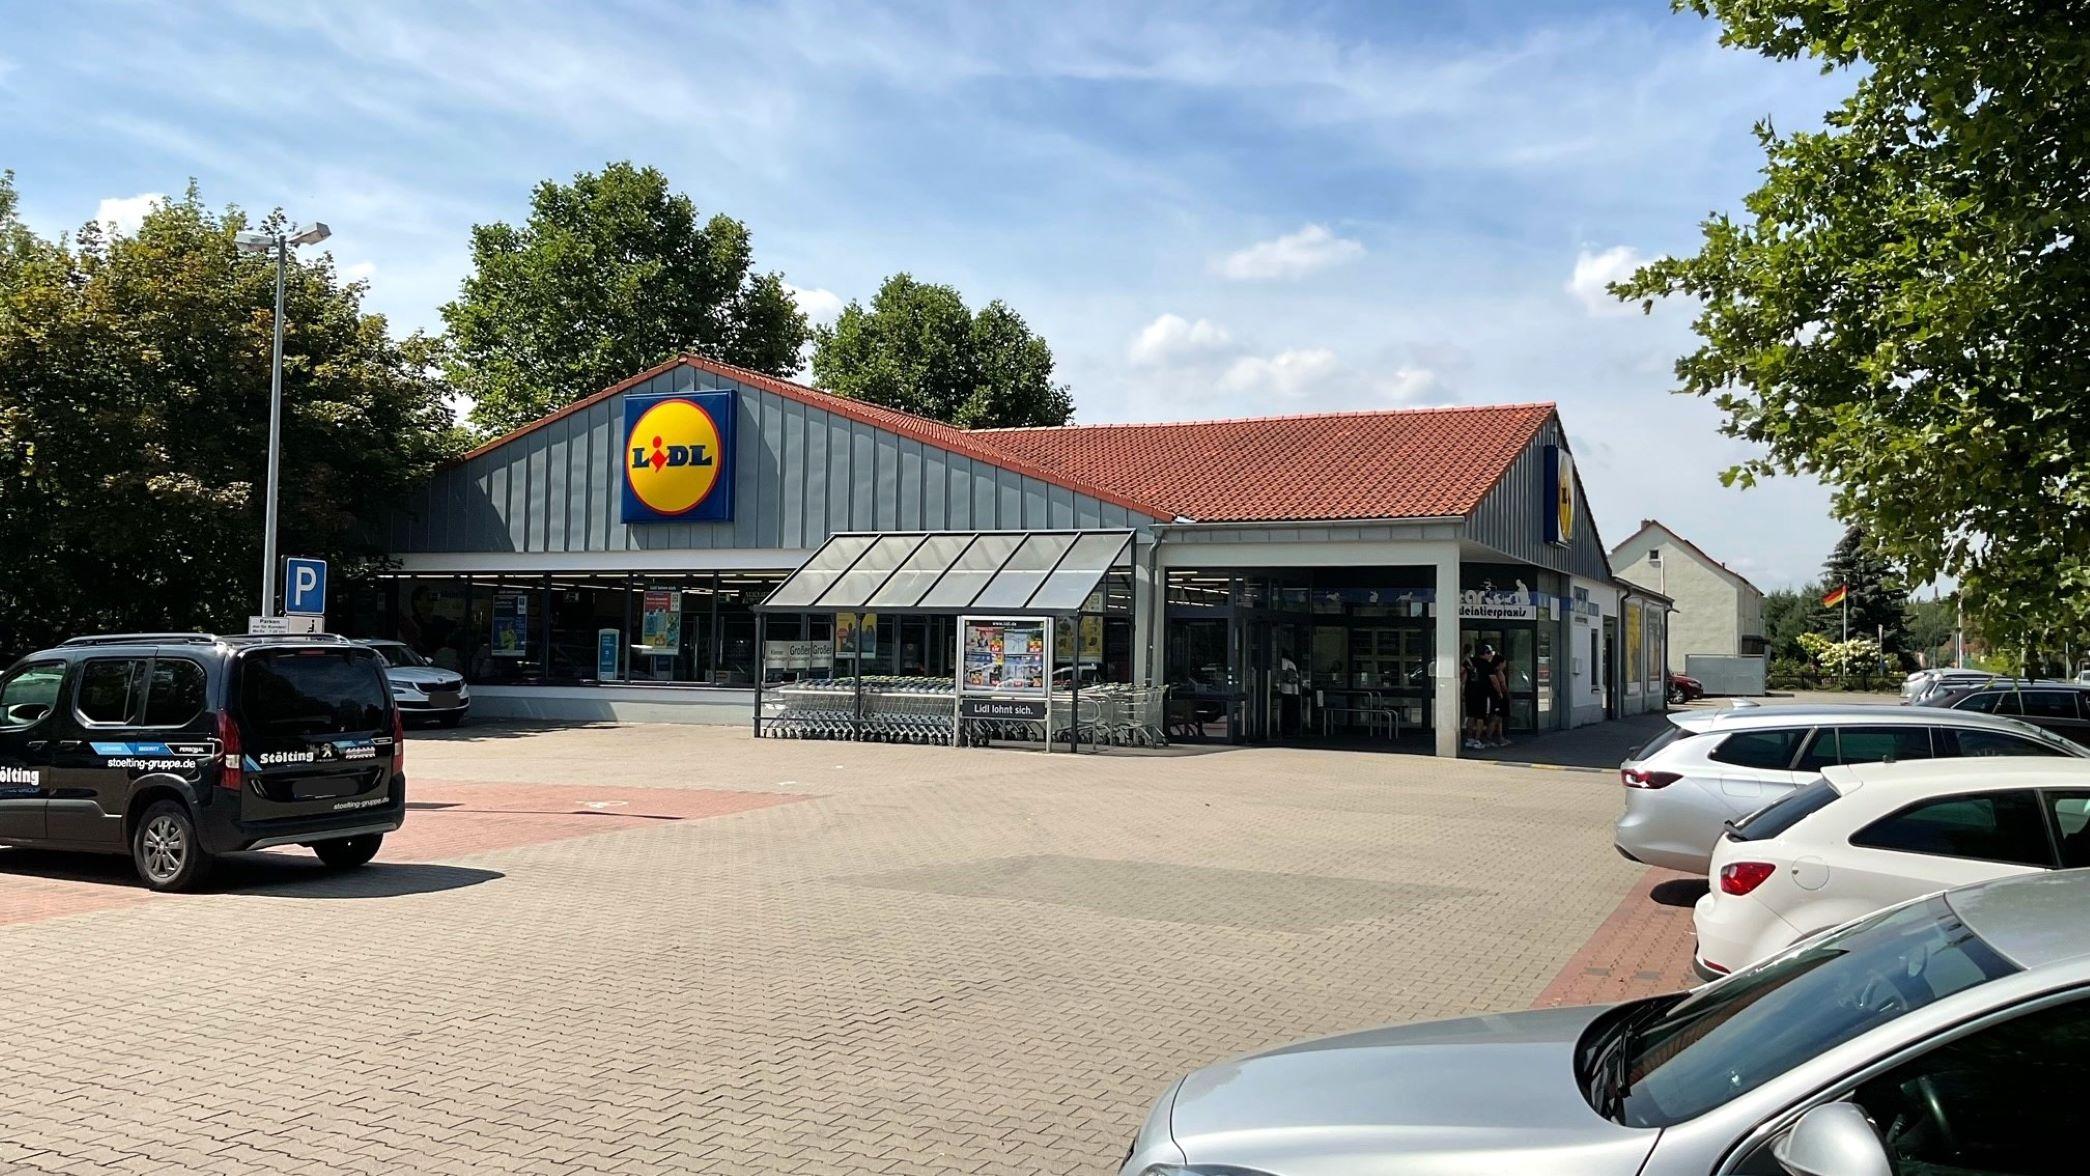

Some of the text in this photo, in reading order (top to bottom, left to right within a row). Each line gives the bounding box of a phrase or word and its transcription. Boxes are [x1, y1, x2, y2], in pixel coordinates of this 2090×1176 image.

[632, 436, 712, 473] LIDL
[295, 566, 317, 606] P
[974, 704, 1034, 715] Lidl lohnt sich.
[107, 758, 196, 770] stoelting-gruppe.de
[260, 751, 314, 764] Stölting
[333, 797, 390, 811] stoelting-gruppe.de
